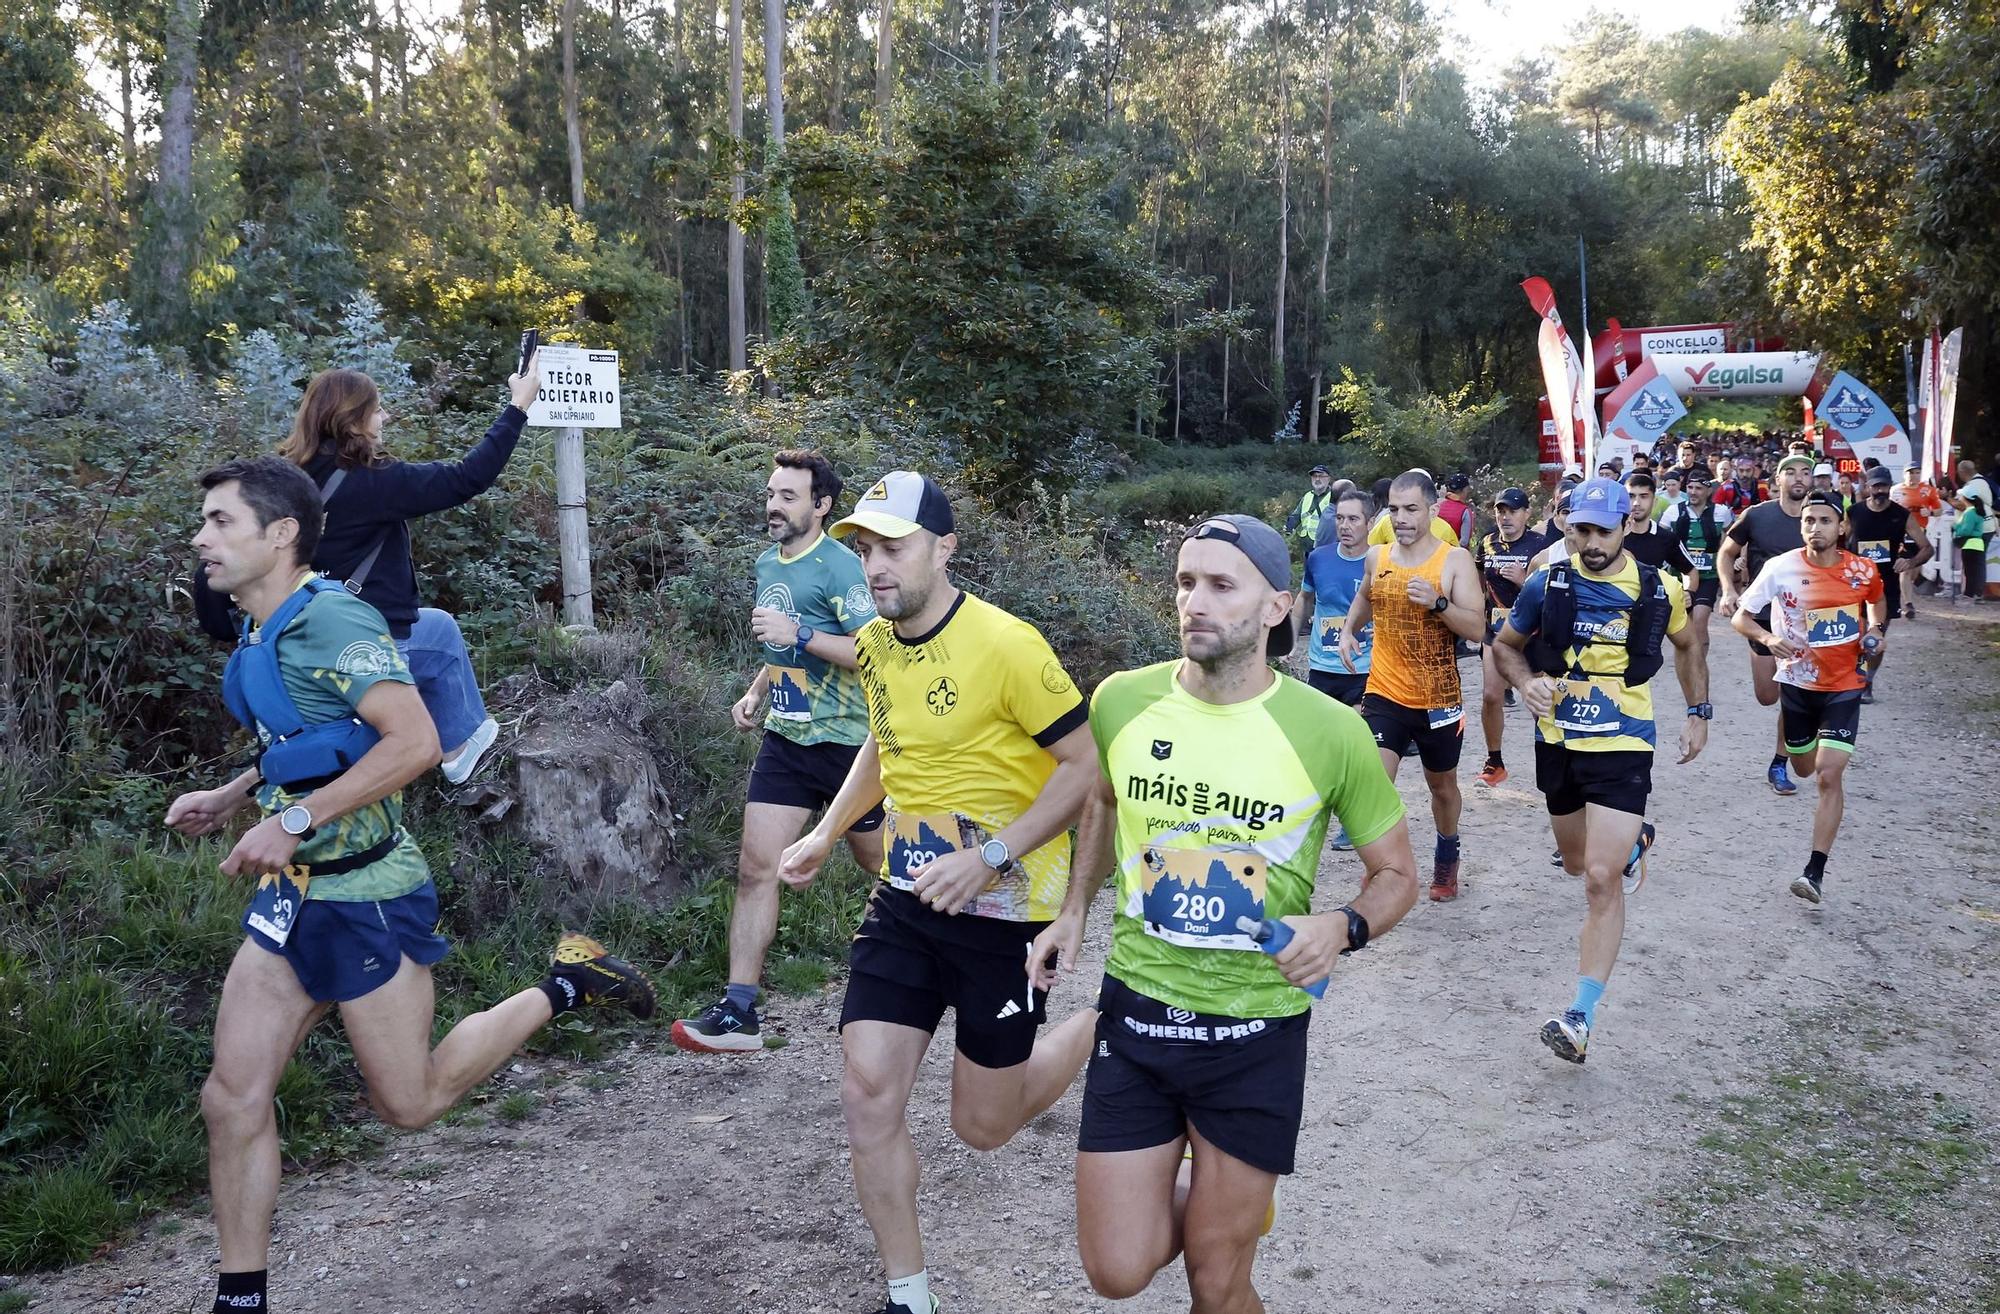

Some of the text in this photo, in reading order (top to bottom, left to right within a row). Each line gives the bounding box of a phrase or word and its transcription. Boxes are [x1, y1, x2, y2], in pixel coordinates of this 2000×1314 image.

[1647, 336, 1718, 350] CONCELLO
[548, 371, 592, 386] TECOR
[1684, 361, 1784, 390] Vegalsa
[539, 388, 614, 404] OCIETARIO
[549, 411, 595, 421] SAN CIPRIANO
[1823, 623, 1847, 636] 419
[772, 688, 790, 705] 211
[1572, 703, 1601, 718] 279
[1127, 773, 1285, 831] máis que auga
[1145, 817, 1201, 835] pensado
[1207, 826, 1242, 844] para
[1172, 892, 1225, 922] 280
[1184, 921, 1210, 933] Dani
[1124, 1016, 1266, 1041] SPHERE PRO
